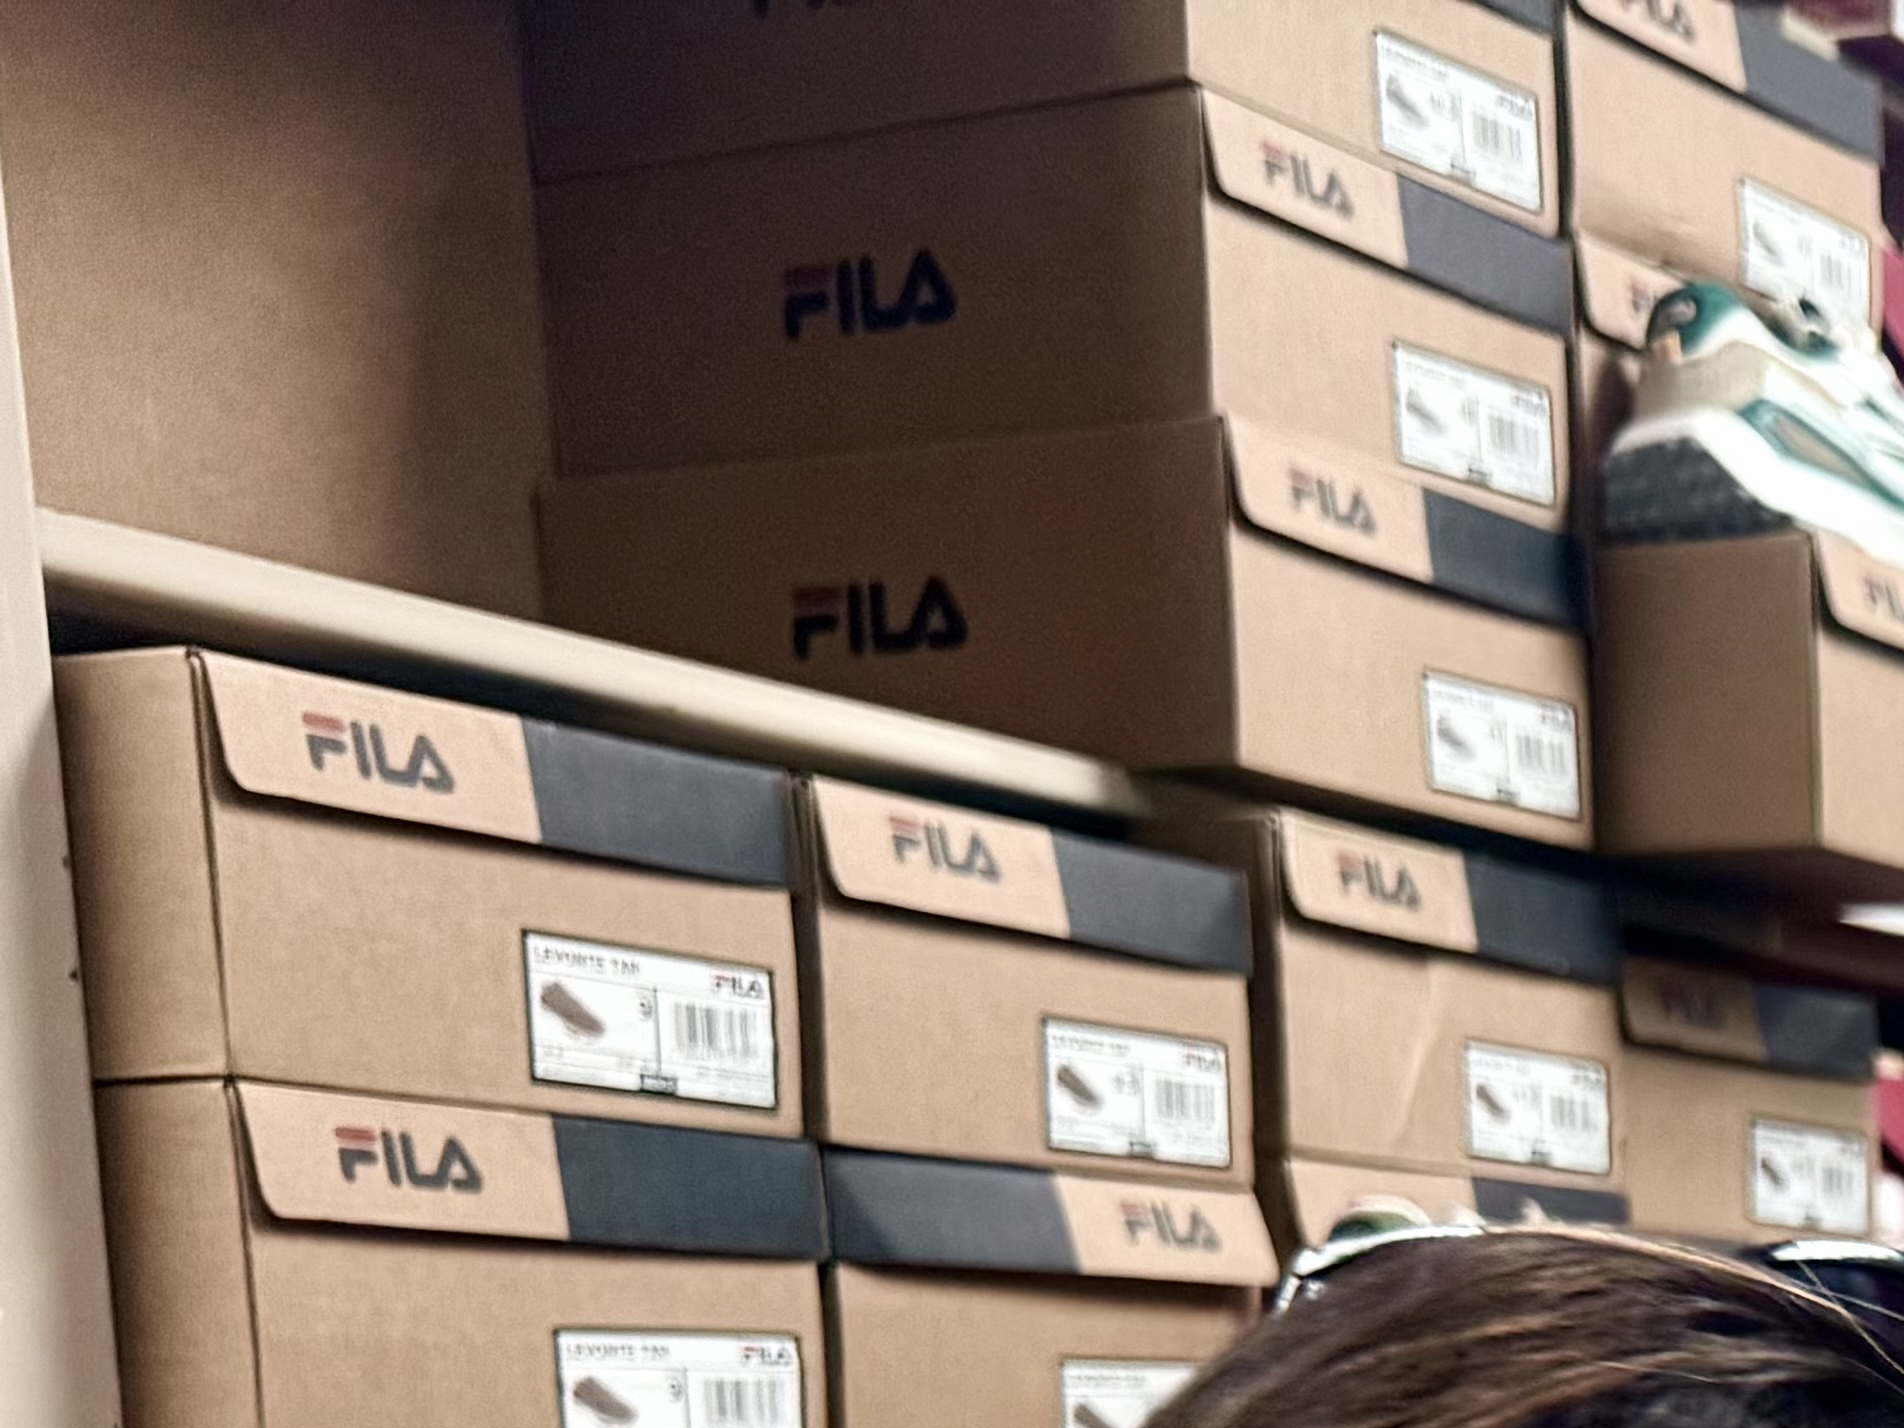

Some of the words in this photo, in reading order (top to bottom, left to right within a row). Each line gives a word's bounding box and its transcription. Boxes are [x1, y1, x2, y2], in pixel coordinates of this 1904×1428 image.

[1260, 140, 1354, 220] FILA
[783, 248, 957, 340] FILA
[1288, 466, 1377, 536] FILA
[792, 574, 967, 660] FILA
[302, 712, 455, 794] FILA
[888, 816, 1001, 882] FILA
[1336, 849, 1421, 910] FILA
[713, 969, 763, 999] FILA
[335, 1126, 482, 1194] FILA
[1118, 1199, 1223, 1252] FILA
[741, 1345, 792, 1366] FILA
